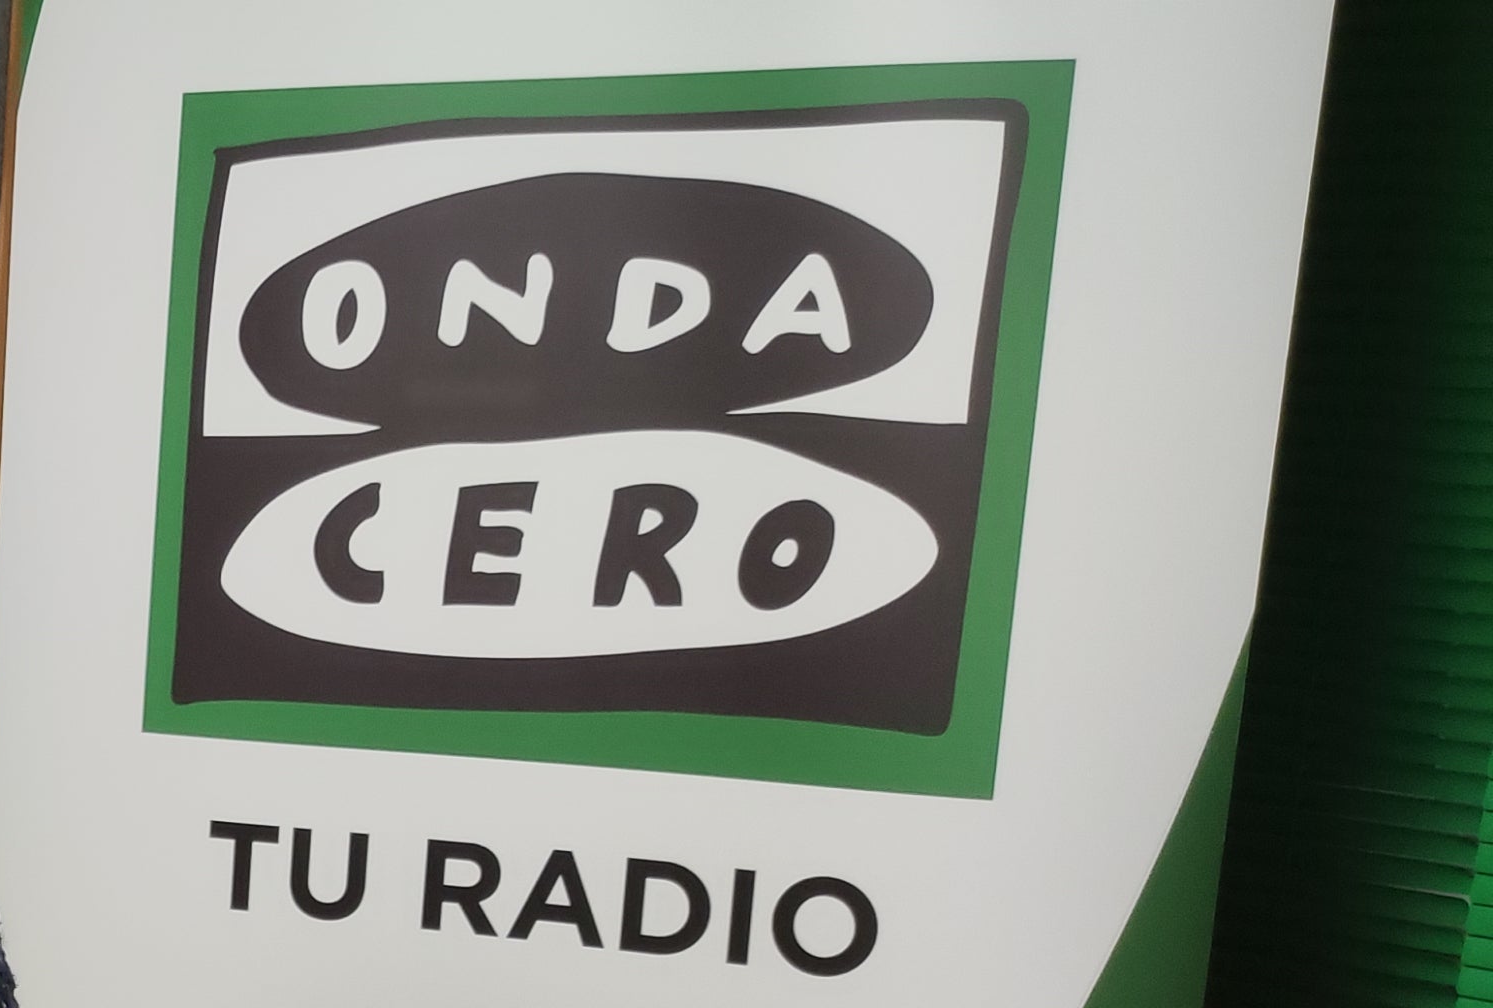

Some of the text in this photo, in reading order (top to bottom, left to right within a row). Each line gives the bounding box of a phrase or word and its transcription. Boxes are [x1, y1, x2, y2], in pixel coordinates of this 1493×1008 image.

[301, 252, 851, 370] ONDA
[314, 481, 835, 611] CERO
[210, 819, 879, 977] TU RADIO
